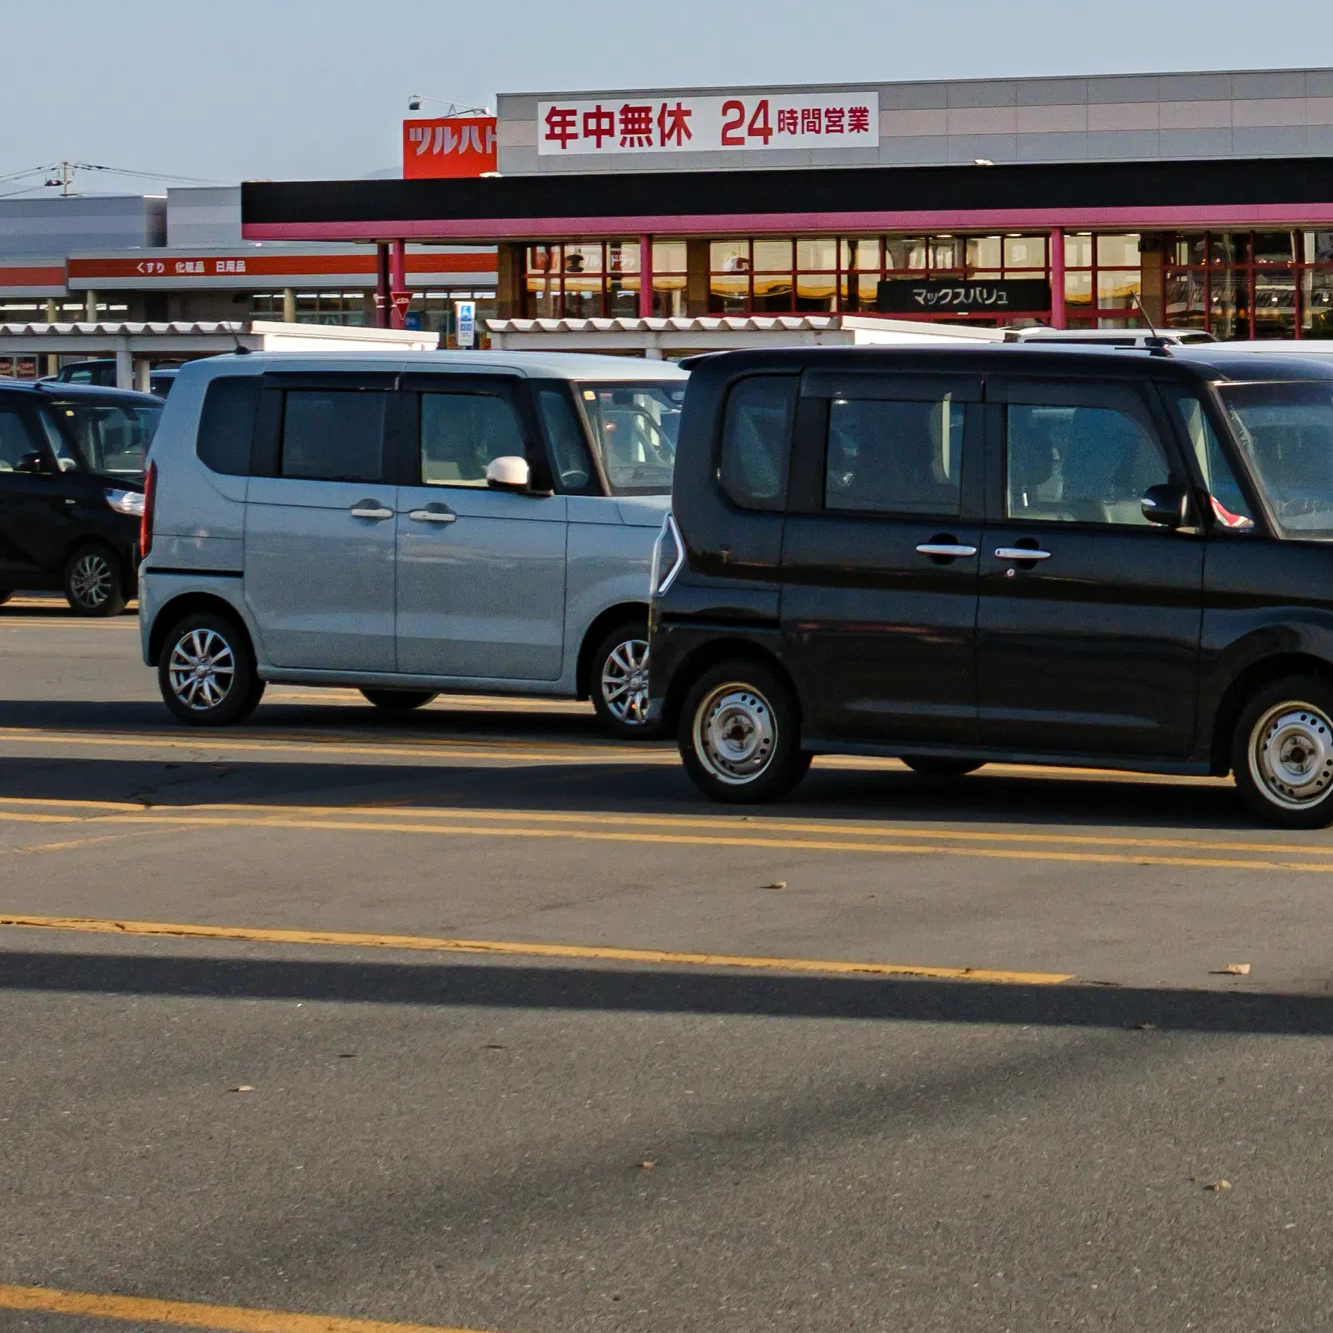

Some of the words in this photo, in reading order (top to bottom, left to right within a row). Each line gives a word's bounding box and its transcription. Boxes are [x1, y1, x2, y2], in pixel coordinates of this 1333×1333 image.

[544, 102, 692, 150] 年中無休
[721, 99, 870, 146] 24時間営業
[136, 262, 165, 273] くすり
[216, 260, 246, 273] 日用品
[912, 287, 1009, 305] マックスバリュ
